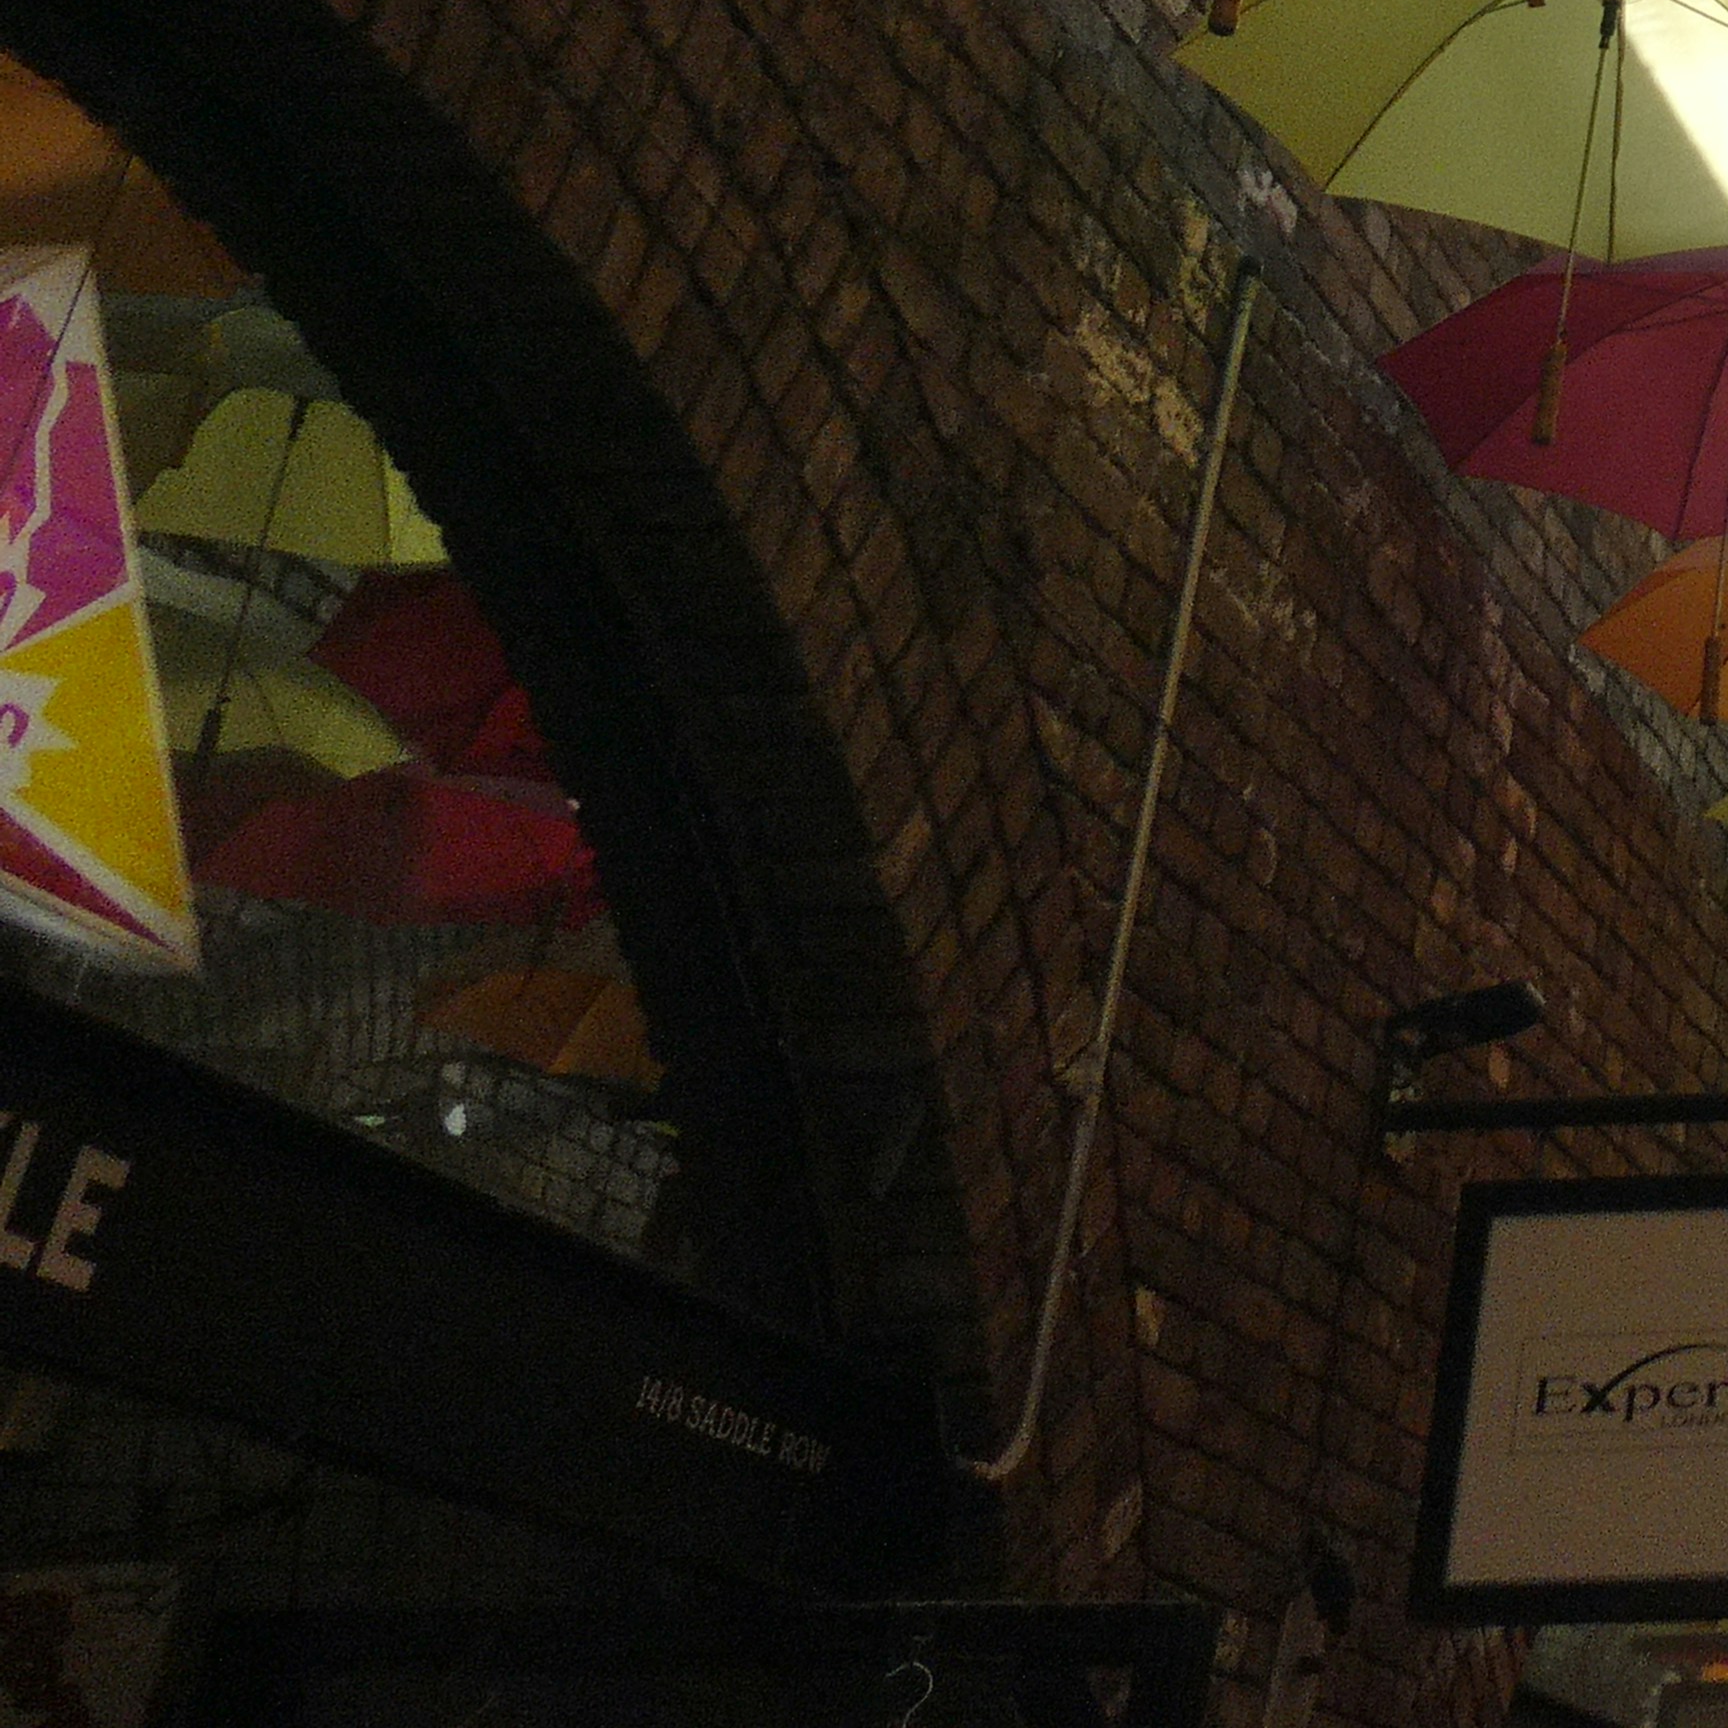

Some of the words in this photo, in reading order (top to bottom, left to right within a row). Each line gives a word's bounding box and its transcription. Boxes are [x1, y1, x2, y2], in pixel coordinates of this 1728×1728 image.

[0, 1112, 131, 1293] LE
[686, 1394, 777, 1456] SADDLE
[778, 1430, 832, 1473] ROW
